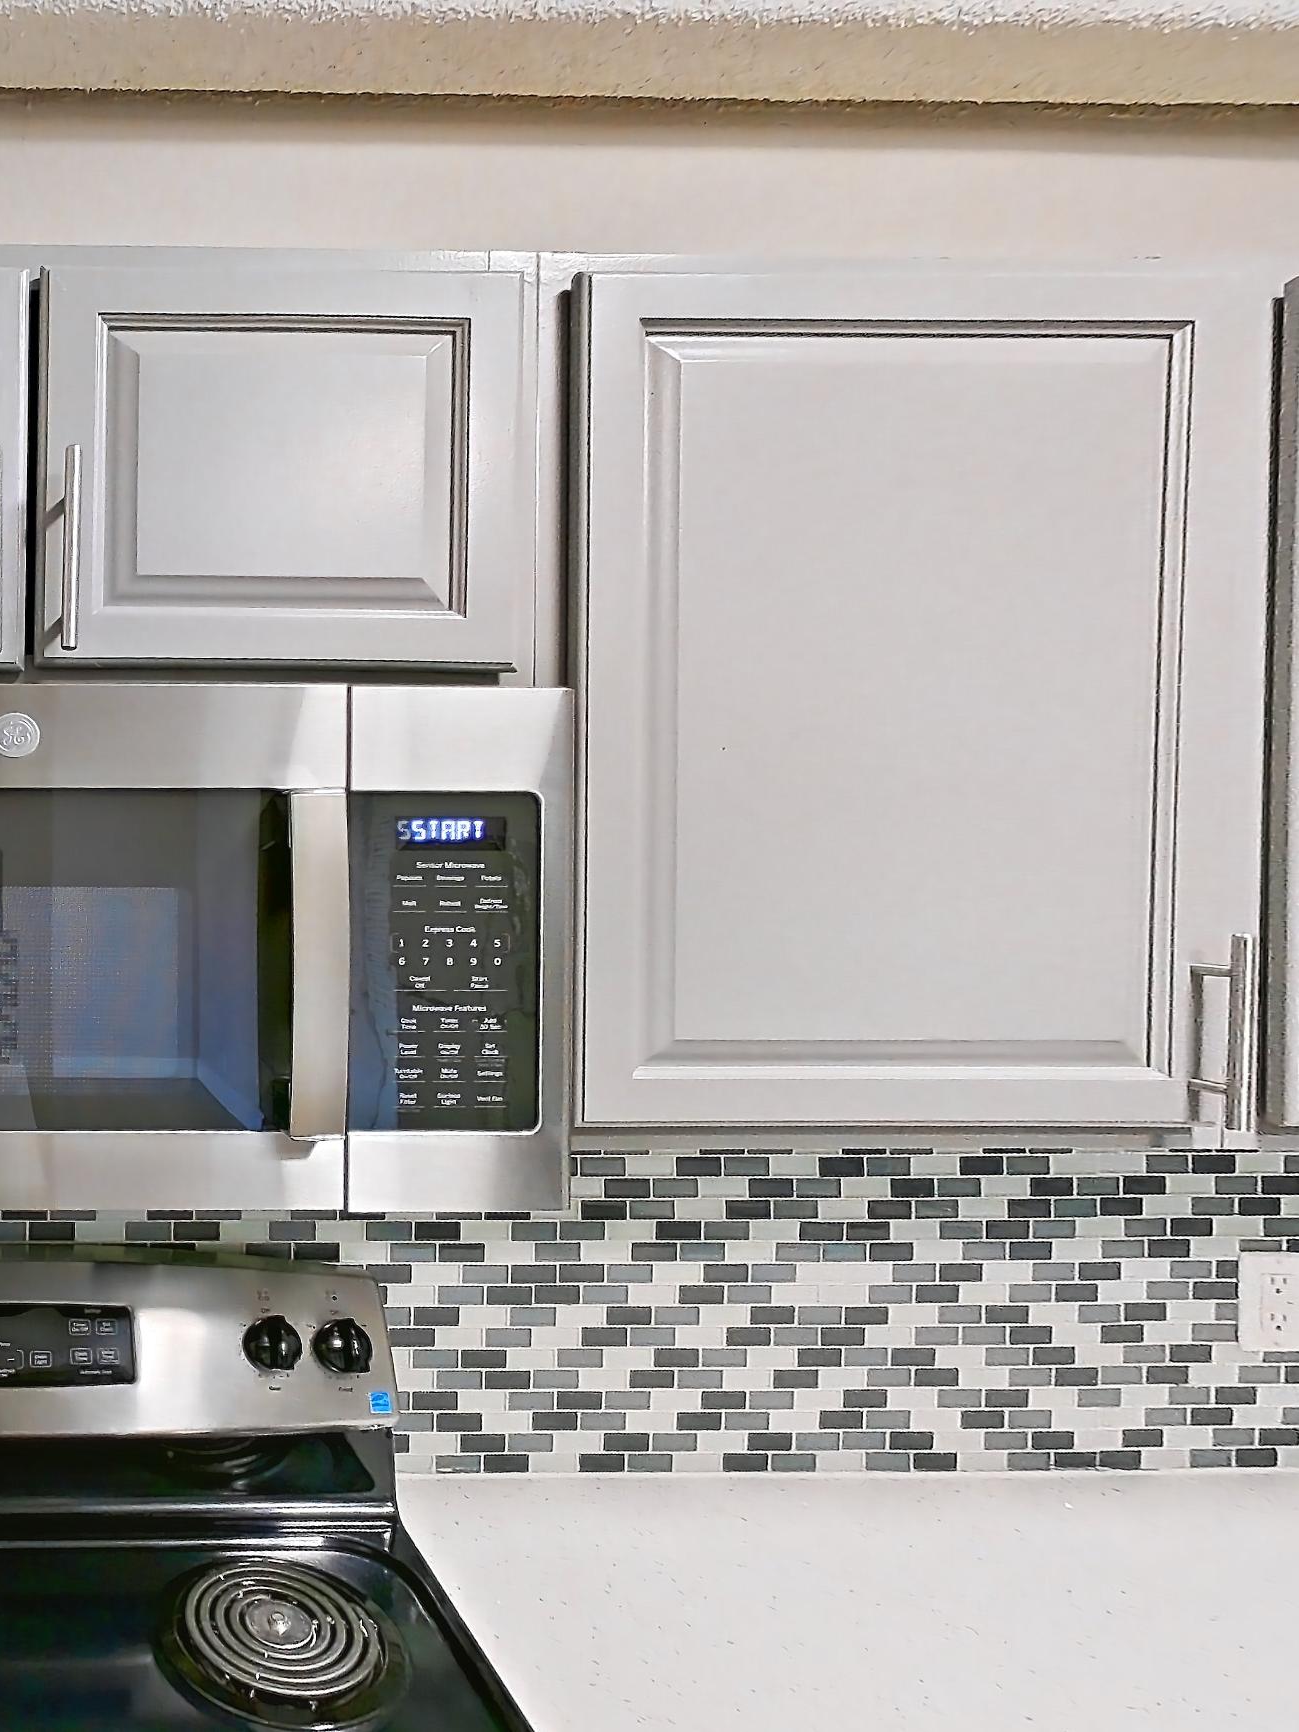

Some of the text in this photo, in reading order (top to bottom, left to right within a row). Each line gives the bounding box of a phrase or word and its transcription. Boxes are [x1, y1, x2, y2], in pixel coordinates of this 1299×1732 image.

[444, 861, 486, 869] Microwave
[398, 939, 501, 947] 1 2 3 4 5
[398, 957, 501, 966] 6 7 8 9 0
